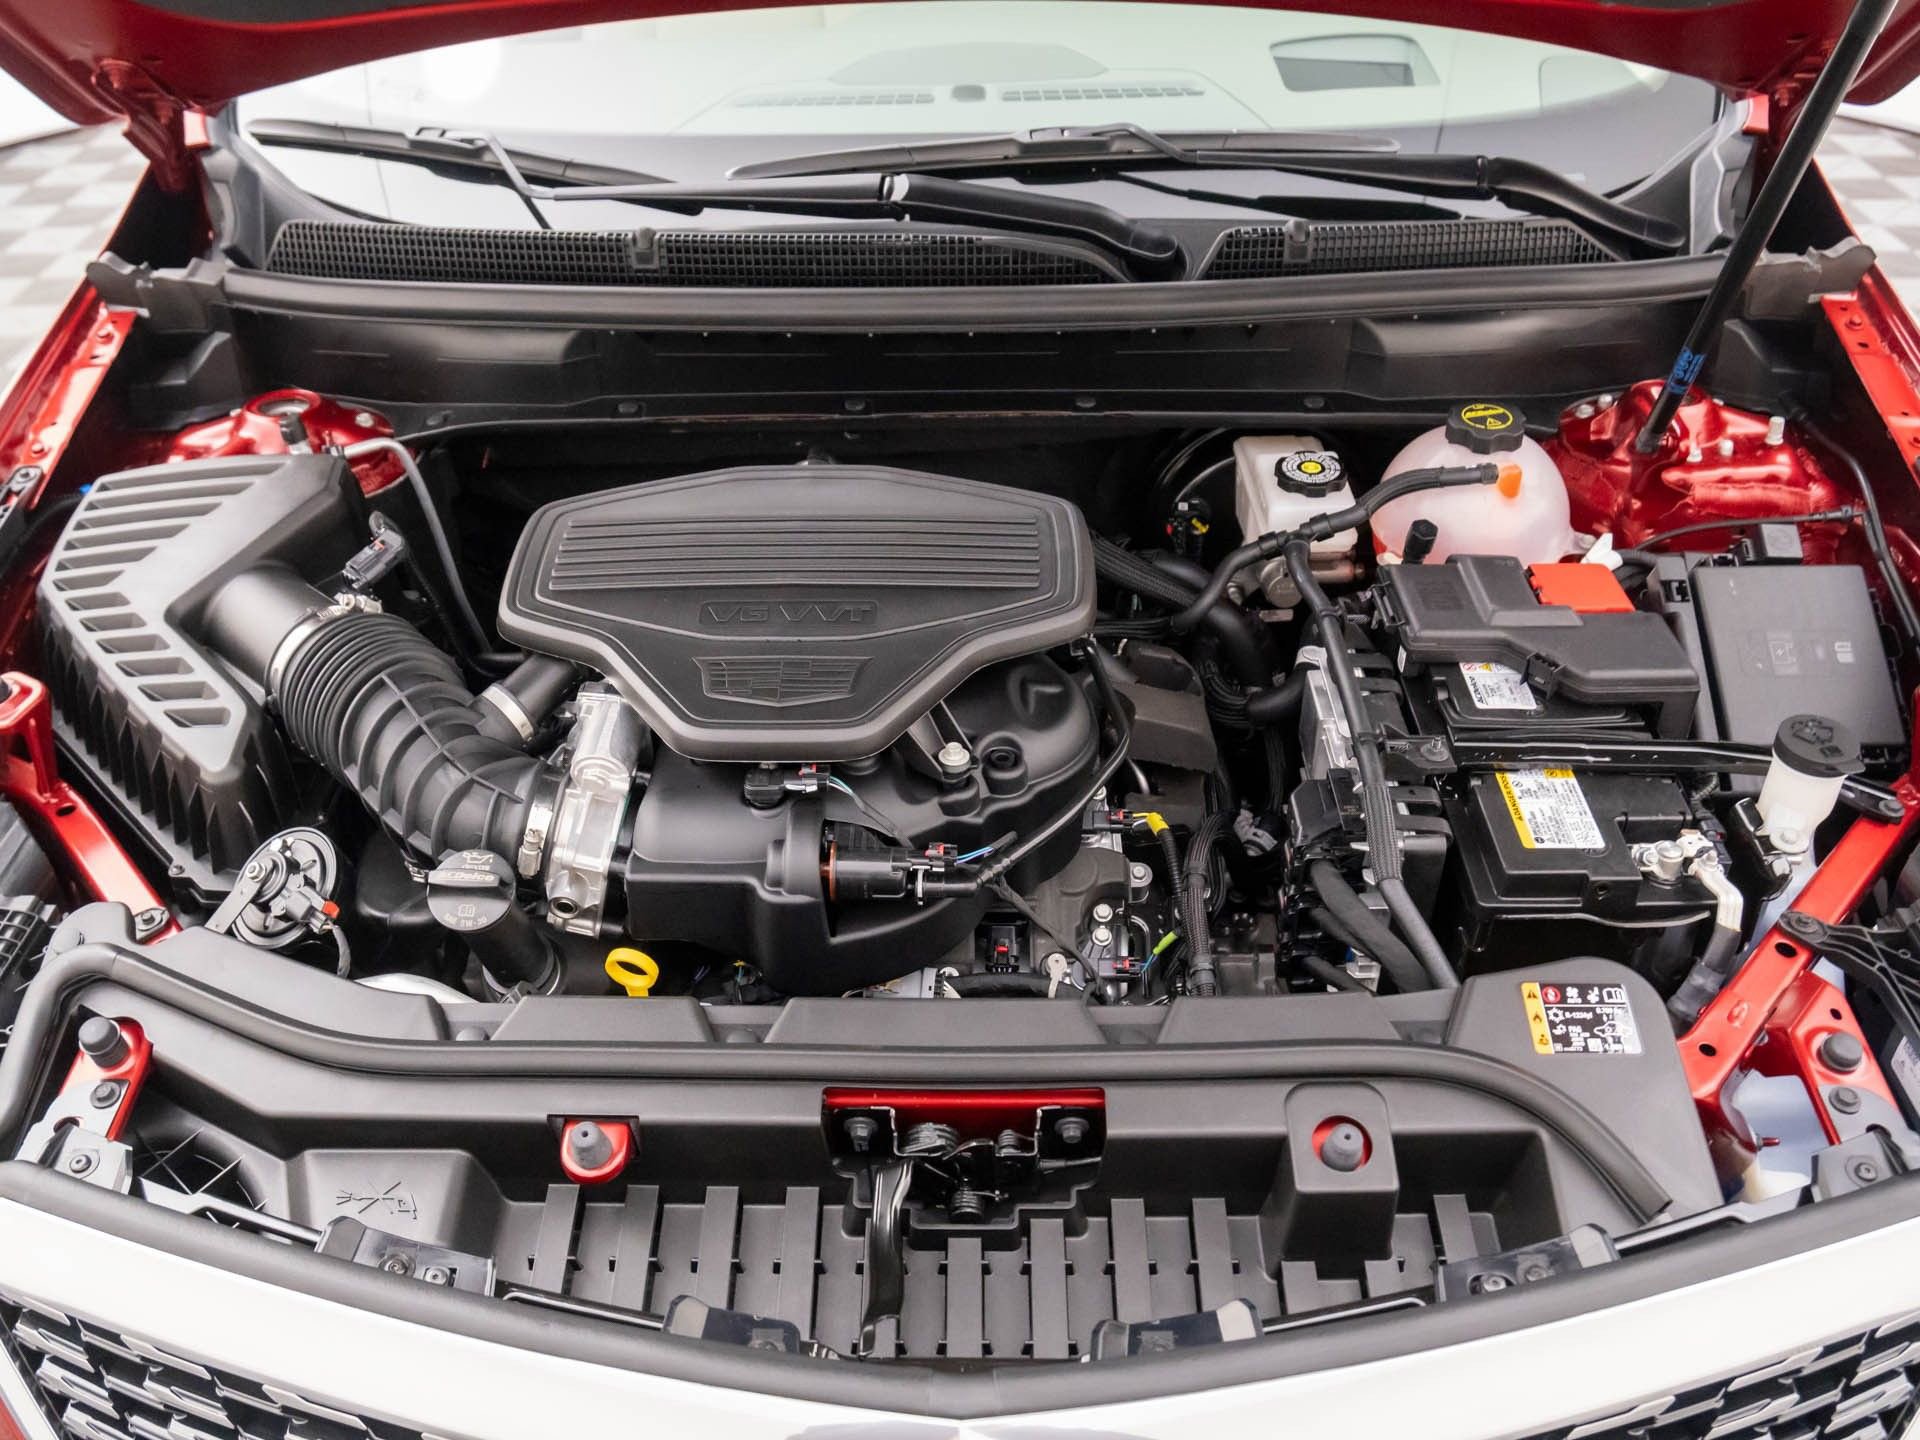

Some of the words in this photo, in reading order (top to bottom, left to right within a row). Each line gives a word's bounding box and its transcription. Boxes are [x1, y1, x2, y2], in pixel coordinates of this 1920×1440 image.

[707, 605, 769, 622] V6
[779, 605, 873, 622] VVT
[440, 871, 495, 881] CDelco
